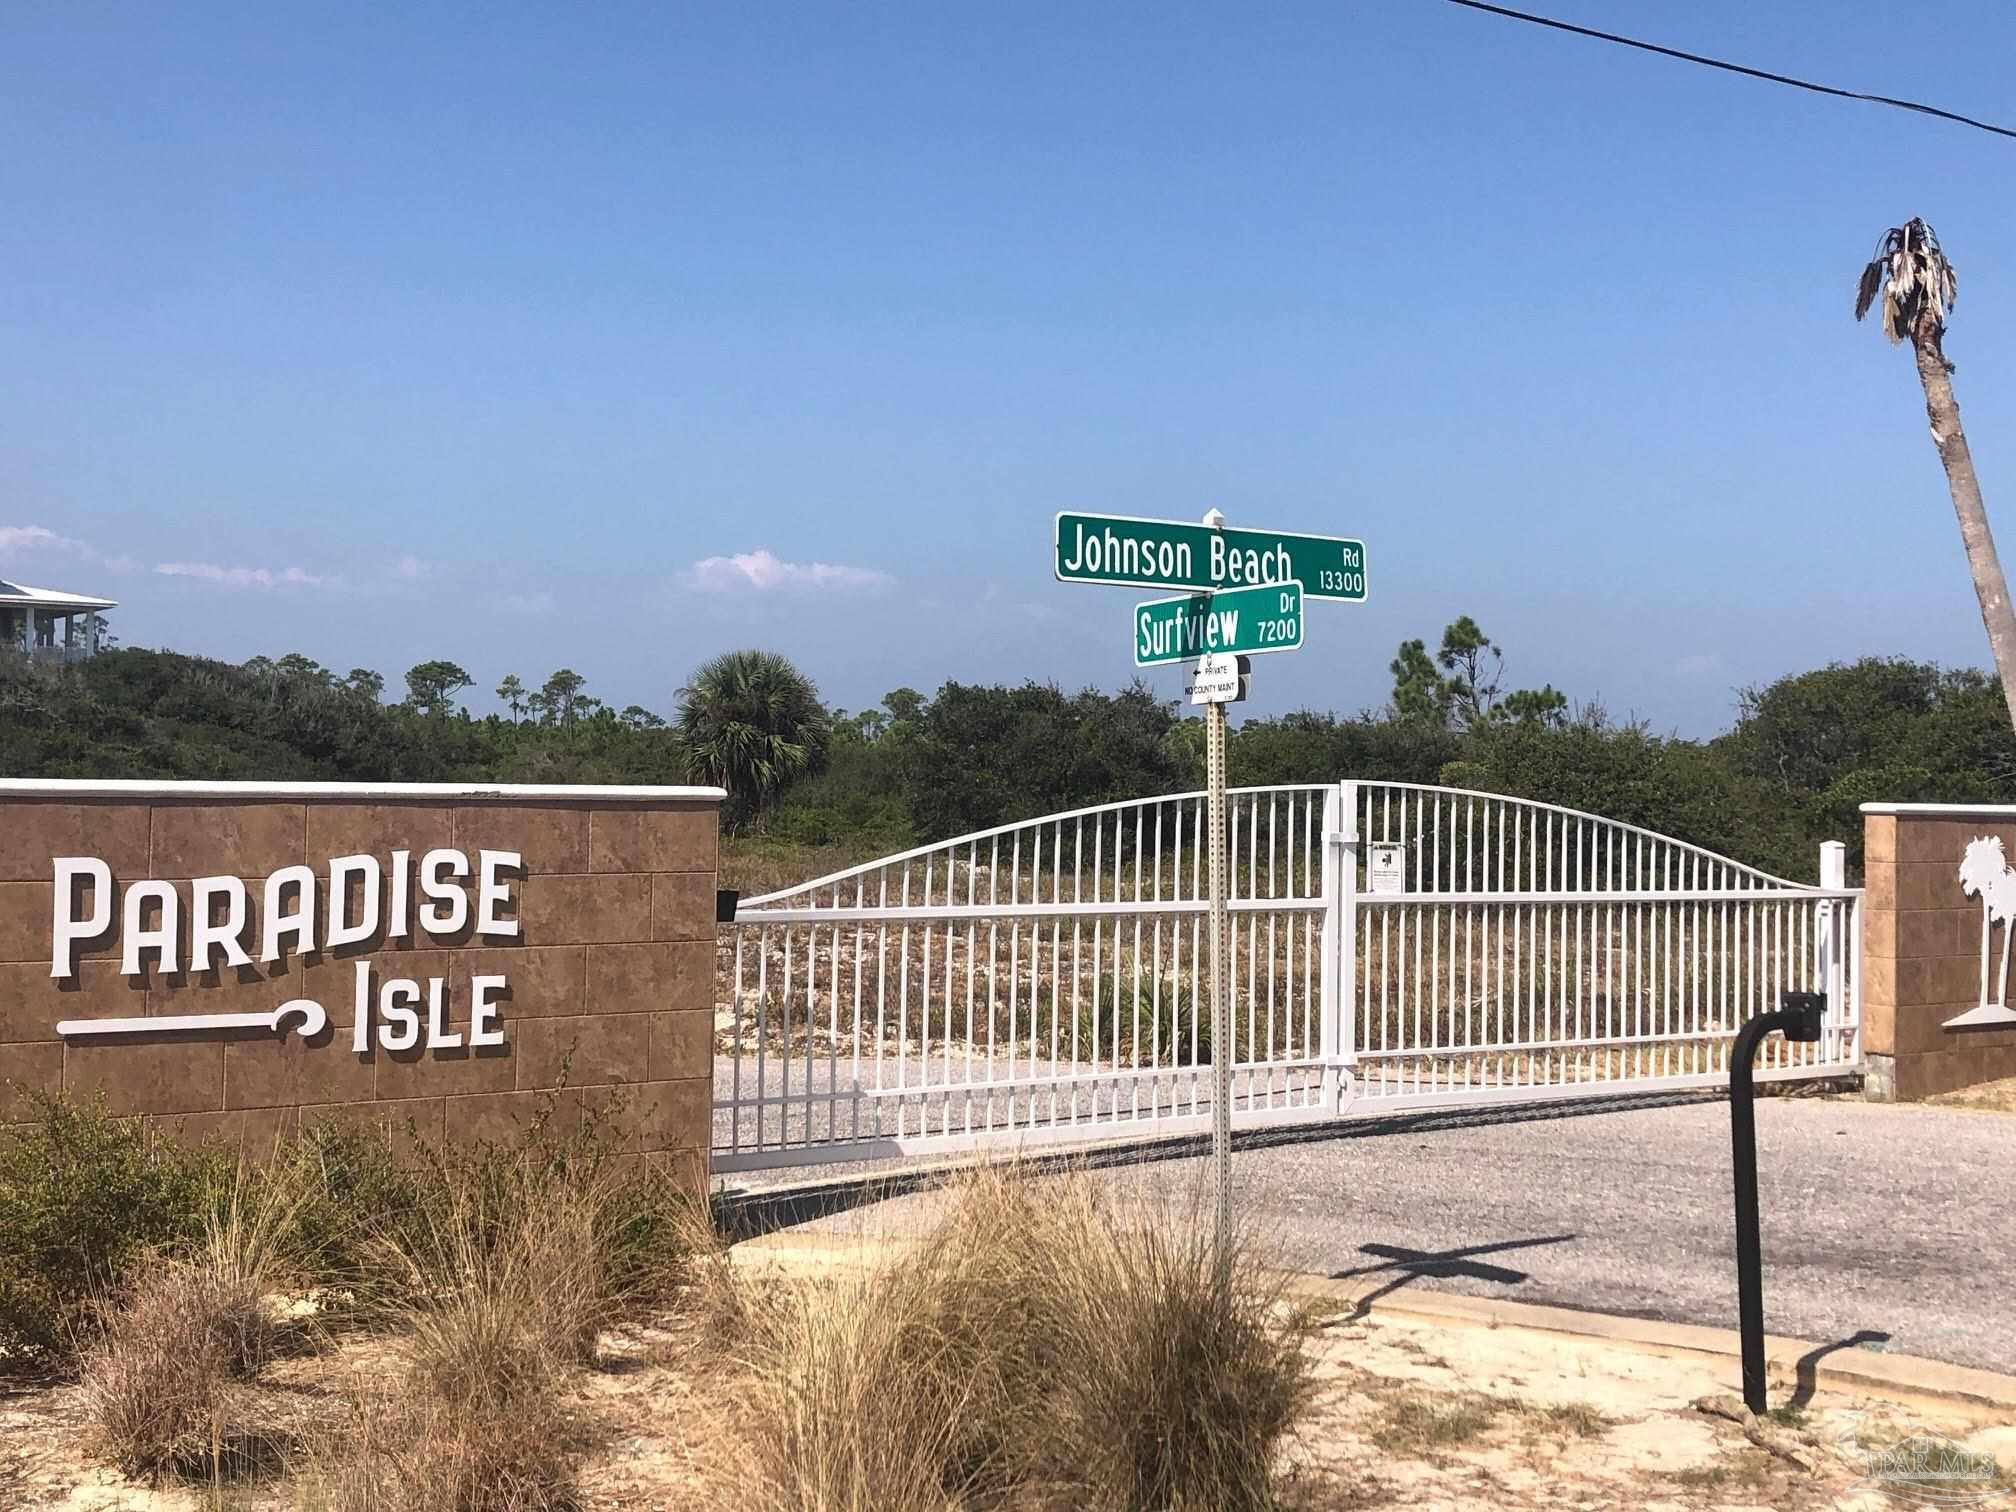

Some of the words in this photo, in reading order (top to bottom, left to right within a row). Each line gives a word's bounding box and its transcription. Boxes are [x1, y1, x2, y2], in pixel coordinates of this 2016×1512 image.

[1064, 523, 1192, 578] Johnson
[1210, 535, 1292, 584] Beach
[1343, 548, 1360, 568] Rd
[1319, 570, 1363, 593] 13300
[1279, 592, 1296, 613] Dr
[1140, 604, 1239, 657] Surfview
[1257, 621, 1297, 643] 7200
[1205, 665, 1228, 675] PRIVATE
[1184, 686, 1193, 695] NO
[1193, 684, 1216, 694] COUNTY
[1217, 682, 1235, 692] MAINT
[50, 848, 522, 977] PARADISE
[352, 960, 507, 1053] ISLE
